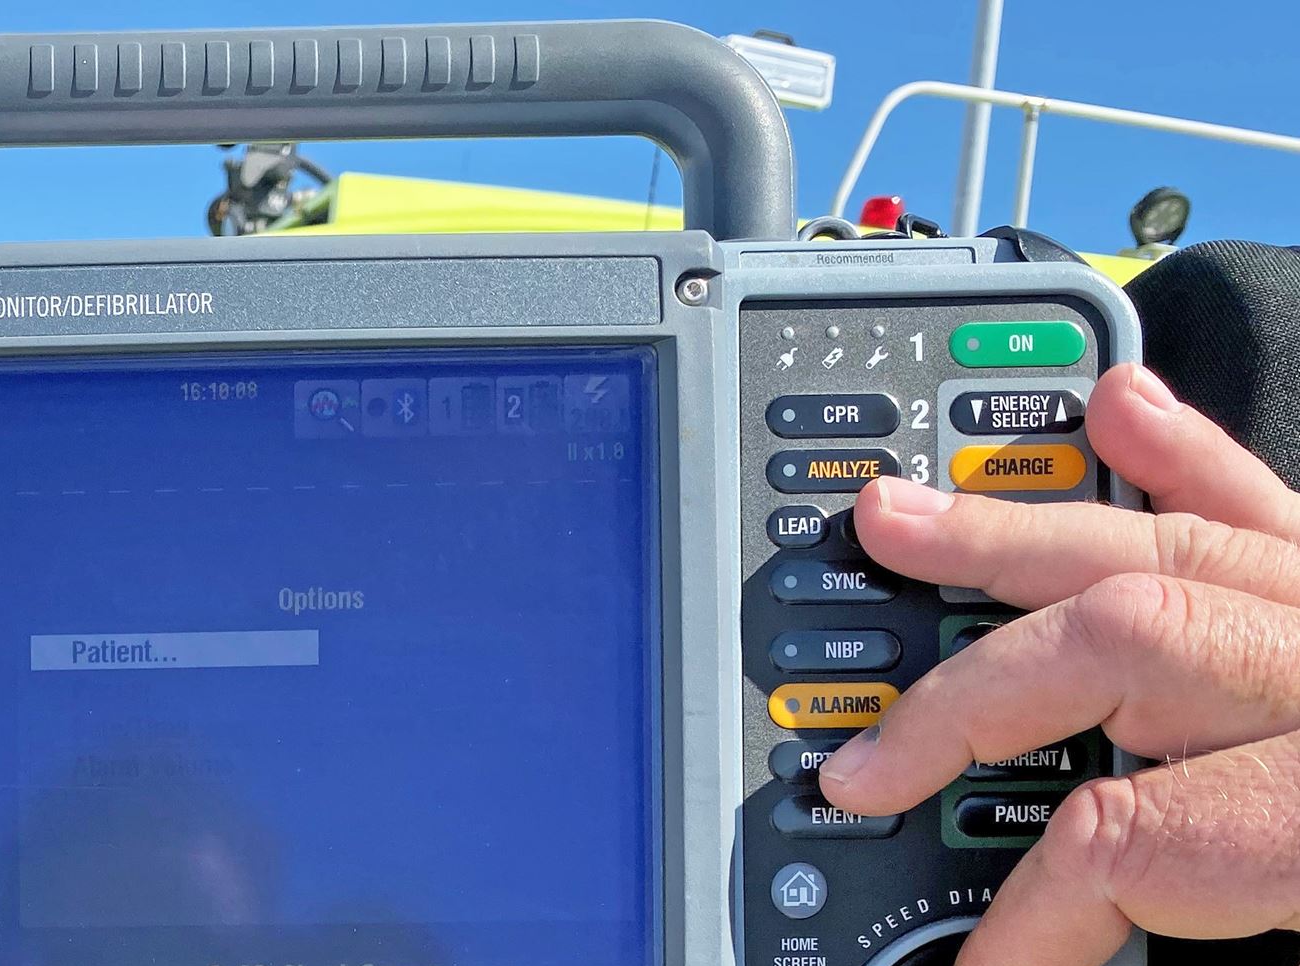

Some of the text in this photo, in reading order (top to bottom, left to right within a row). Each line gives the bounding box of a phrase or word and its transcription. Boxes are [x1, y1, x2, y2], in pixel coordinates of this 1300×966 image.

[816, 253, 894, 265] Recommended
[909, 332, 924, 362] 1
[1008, 334, 1034, 353] ON
[507, 395, 521, 418] 2
[990, 396, 1050, 412] ENERGY
[823, 405, 859, 423] CPR
[910, 399, 930, 429] 2
[991, 412, 1049, 428] SELECT
[807, 460, 881, 479] ANALYZE
[910, 454, 930, 484] 3
[984, 457, 1054, 476] CHARGE
[778, 517, 822, 535] LEAD
[822, 572, 867, 590] SYNC
[278, 586, 365, 615] Options
[71, 639, 178, 664] Patient...
[825, 641, 864, 659] NIBP
[809, 695, 882, 715] ALARMS
[995, 804, 1050, 823] PAUSE
[857, 898, 930, 949] SPEED
[781, 937, 819, 952] HOME
